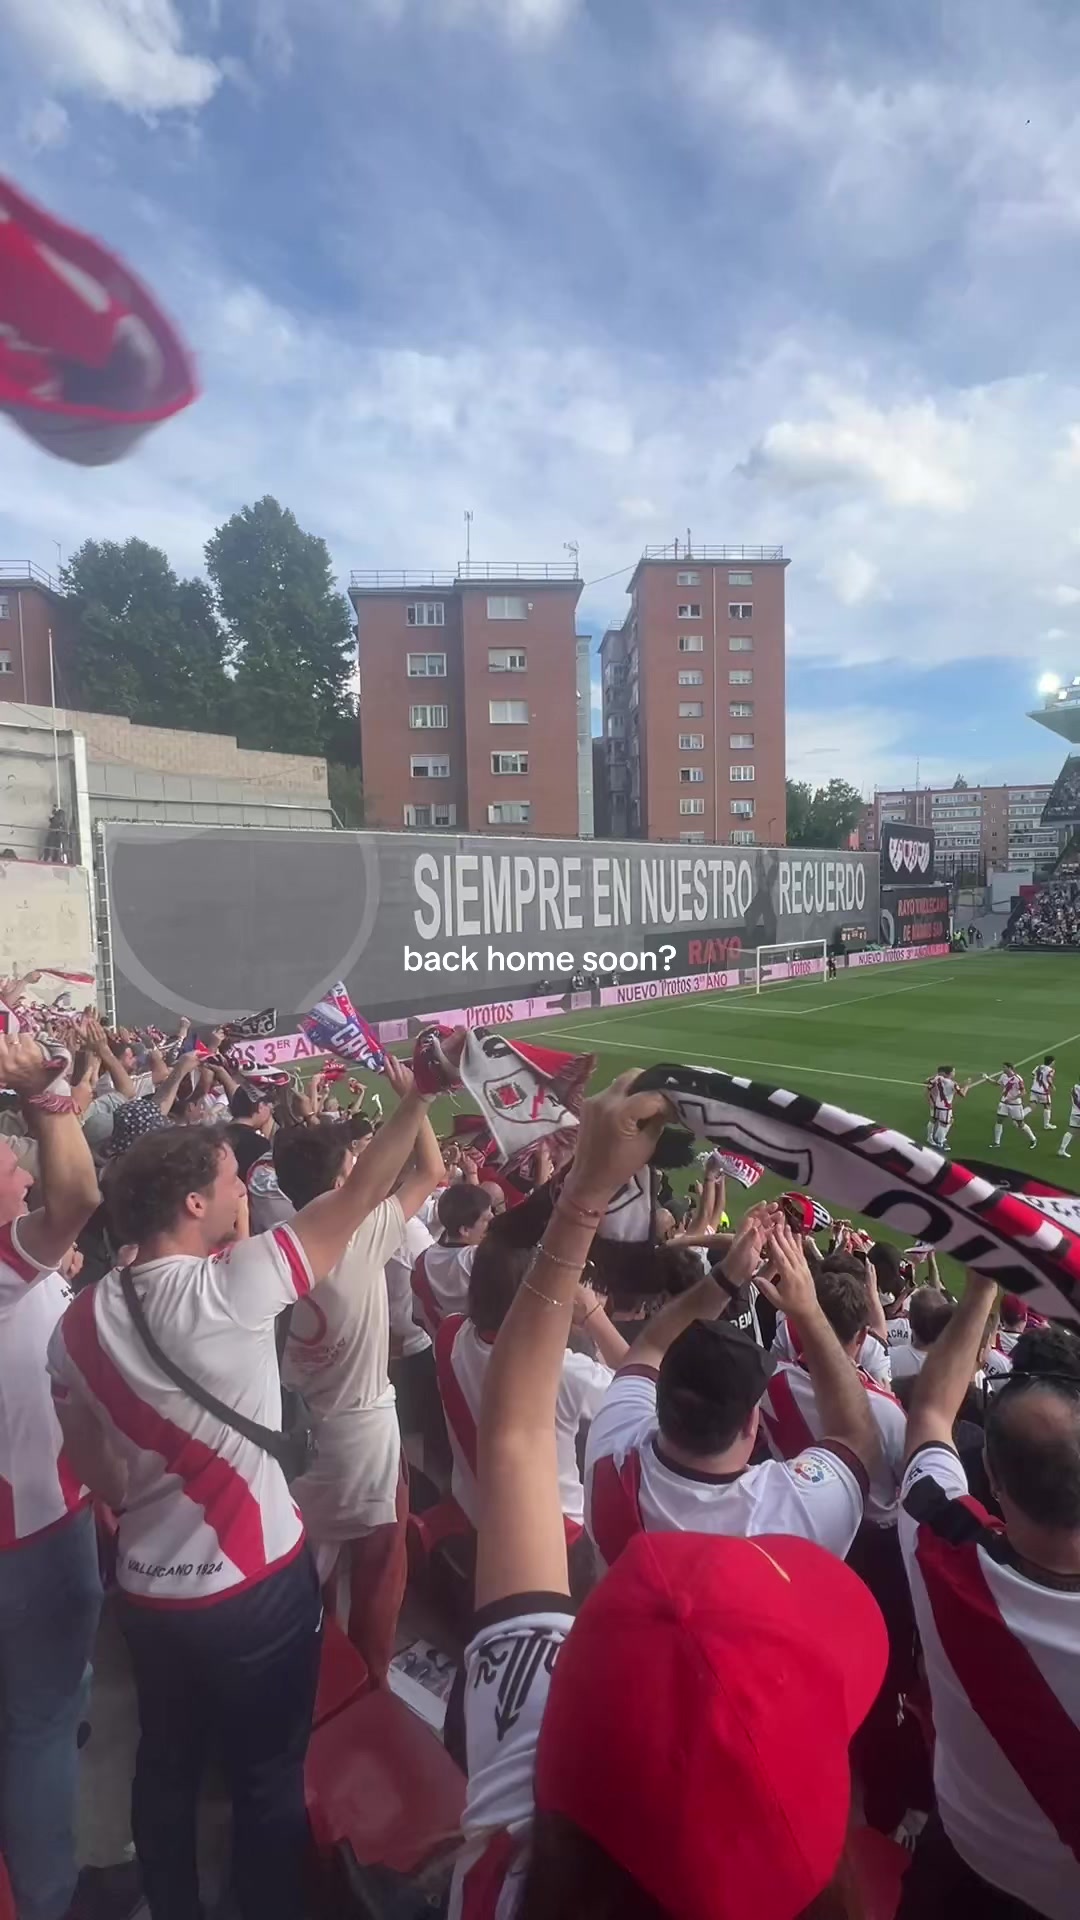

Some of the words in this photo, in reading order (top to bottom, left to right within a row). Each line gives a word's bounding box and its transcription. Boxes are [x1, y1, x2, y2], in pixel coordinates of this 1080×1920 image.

[414, 853, 583, 940] SIEMPRE
[592, 858, 631, 927] EN
[640, 859, 752, 924] NUESTRO
[779, 861, 865, 915] RECUERDO
[688, 936, 742, 965] RAYO
[858, 952, 881, 964] NUEVO
[618, 984, 657, 1002] NUEVO
[660, 978, 692, 997] Protos
[465, 1003, 514, 1028] Protos
[127, 1559, 194, 1577] VALLECANO
